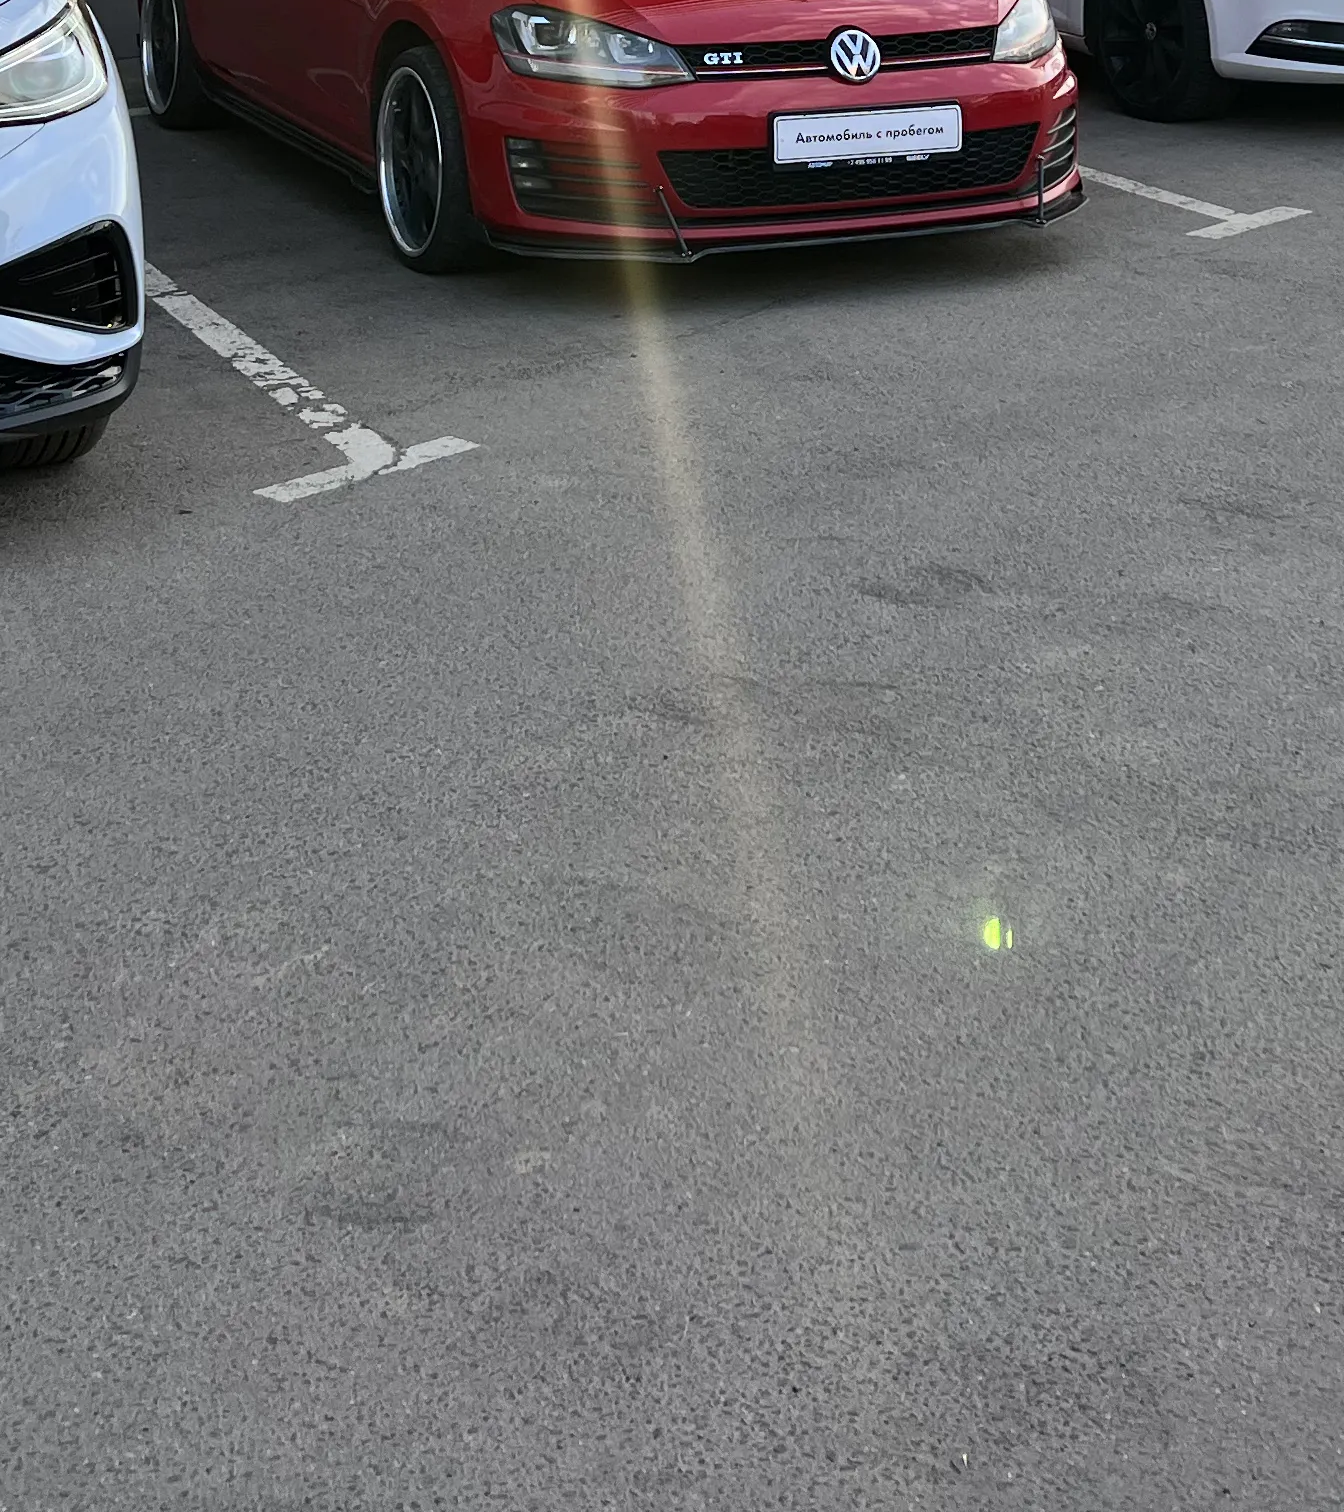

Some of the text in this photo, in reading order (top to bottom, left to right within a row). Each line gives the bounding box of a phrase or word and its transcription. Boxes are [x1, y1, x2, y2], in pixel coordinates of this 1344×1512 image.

[703, 51, 744, 66] GTI
[795, 123, 945, 145] Автомобиль с пробегом
